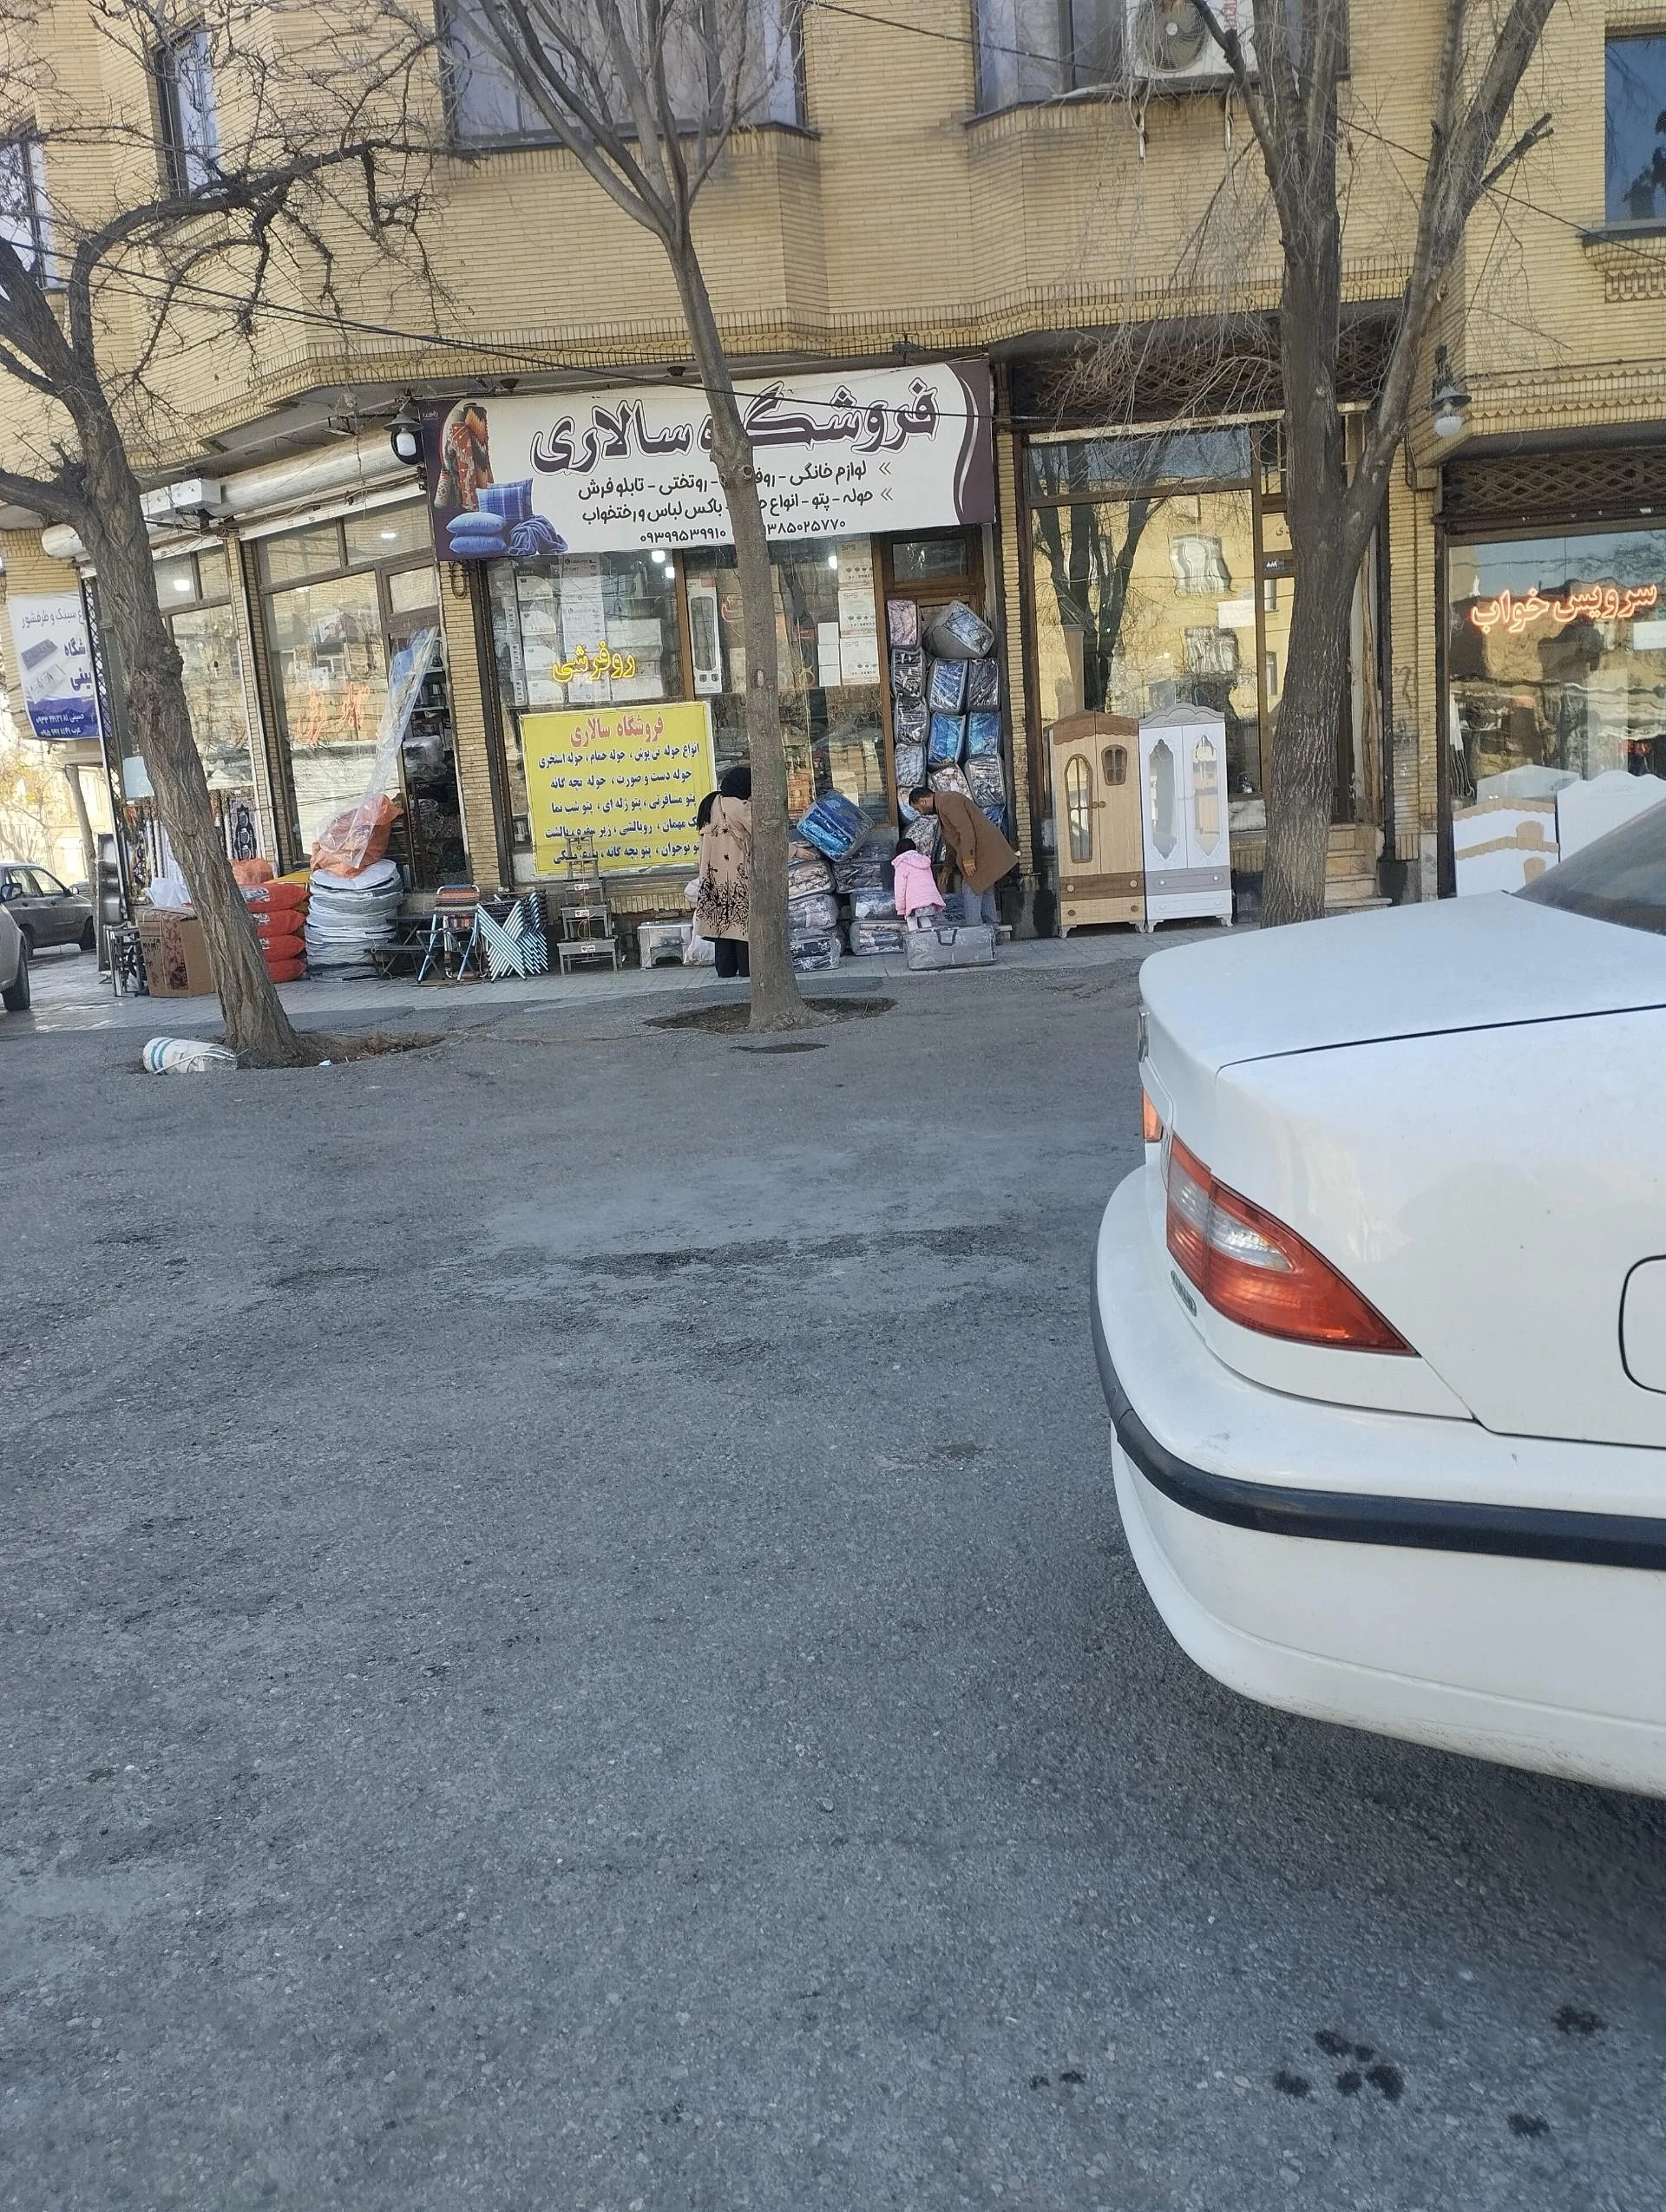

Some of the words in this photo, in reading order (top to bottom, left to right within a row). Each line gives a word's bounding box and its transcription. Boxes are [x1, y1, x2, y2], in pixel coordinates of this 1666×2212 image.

[698, 376, 940, 455] فروشگه
[530, 399, 693, 476] سالاری
[789, 462, 833, 486] خانگی
[835, 460, 867, 485] لوازم
[659, 474, 708, 495] روتختی
[811, 492, 830, 512] پتو
[843, 488, 874, 503] حوله
[647, 501, 683, 522] لباس
[685, 498, 723, 520] باکس
[770, 493, 799, 516] انواع
[640, 527, 726, 544] ۰۹۳۹۹۵۳۹۹۱۰
[767, 519, 846, 535] ۳۸۵۰۲۵۷۷۰
[1471, 586, 1551, 634] خواب
[1552, 583, 1658, 623] سرویس
[552, 640, 636, 684] روفرشی
[570, 717, 611, 748] سالاری
[617, 710, 665, 743] فروشگاه
[590, 750, 607, 765] حمام
[609, 751, 626, 764] حوله
[664, 746, 680, 759] حوله
[682, 742, 700, 759] انواع
[539, 753, 565, 769] استخری
[567, 754, 584, 766] حوله
[587, 776, 607, 788] حوله
[616, 773, 642, 786] صورت
[644, 775, 649, 786] و
[650, 769, 671, 782] دست
[672, 769, 692, 782] حوله
[631, 798, 641, 811] پتو
[685, 793, 696, 807] پتو
[582, 803, 593, 815] پتو
[662, 817, 685, 833] مهمان
[641, 845, 651, 858] پتو
